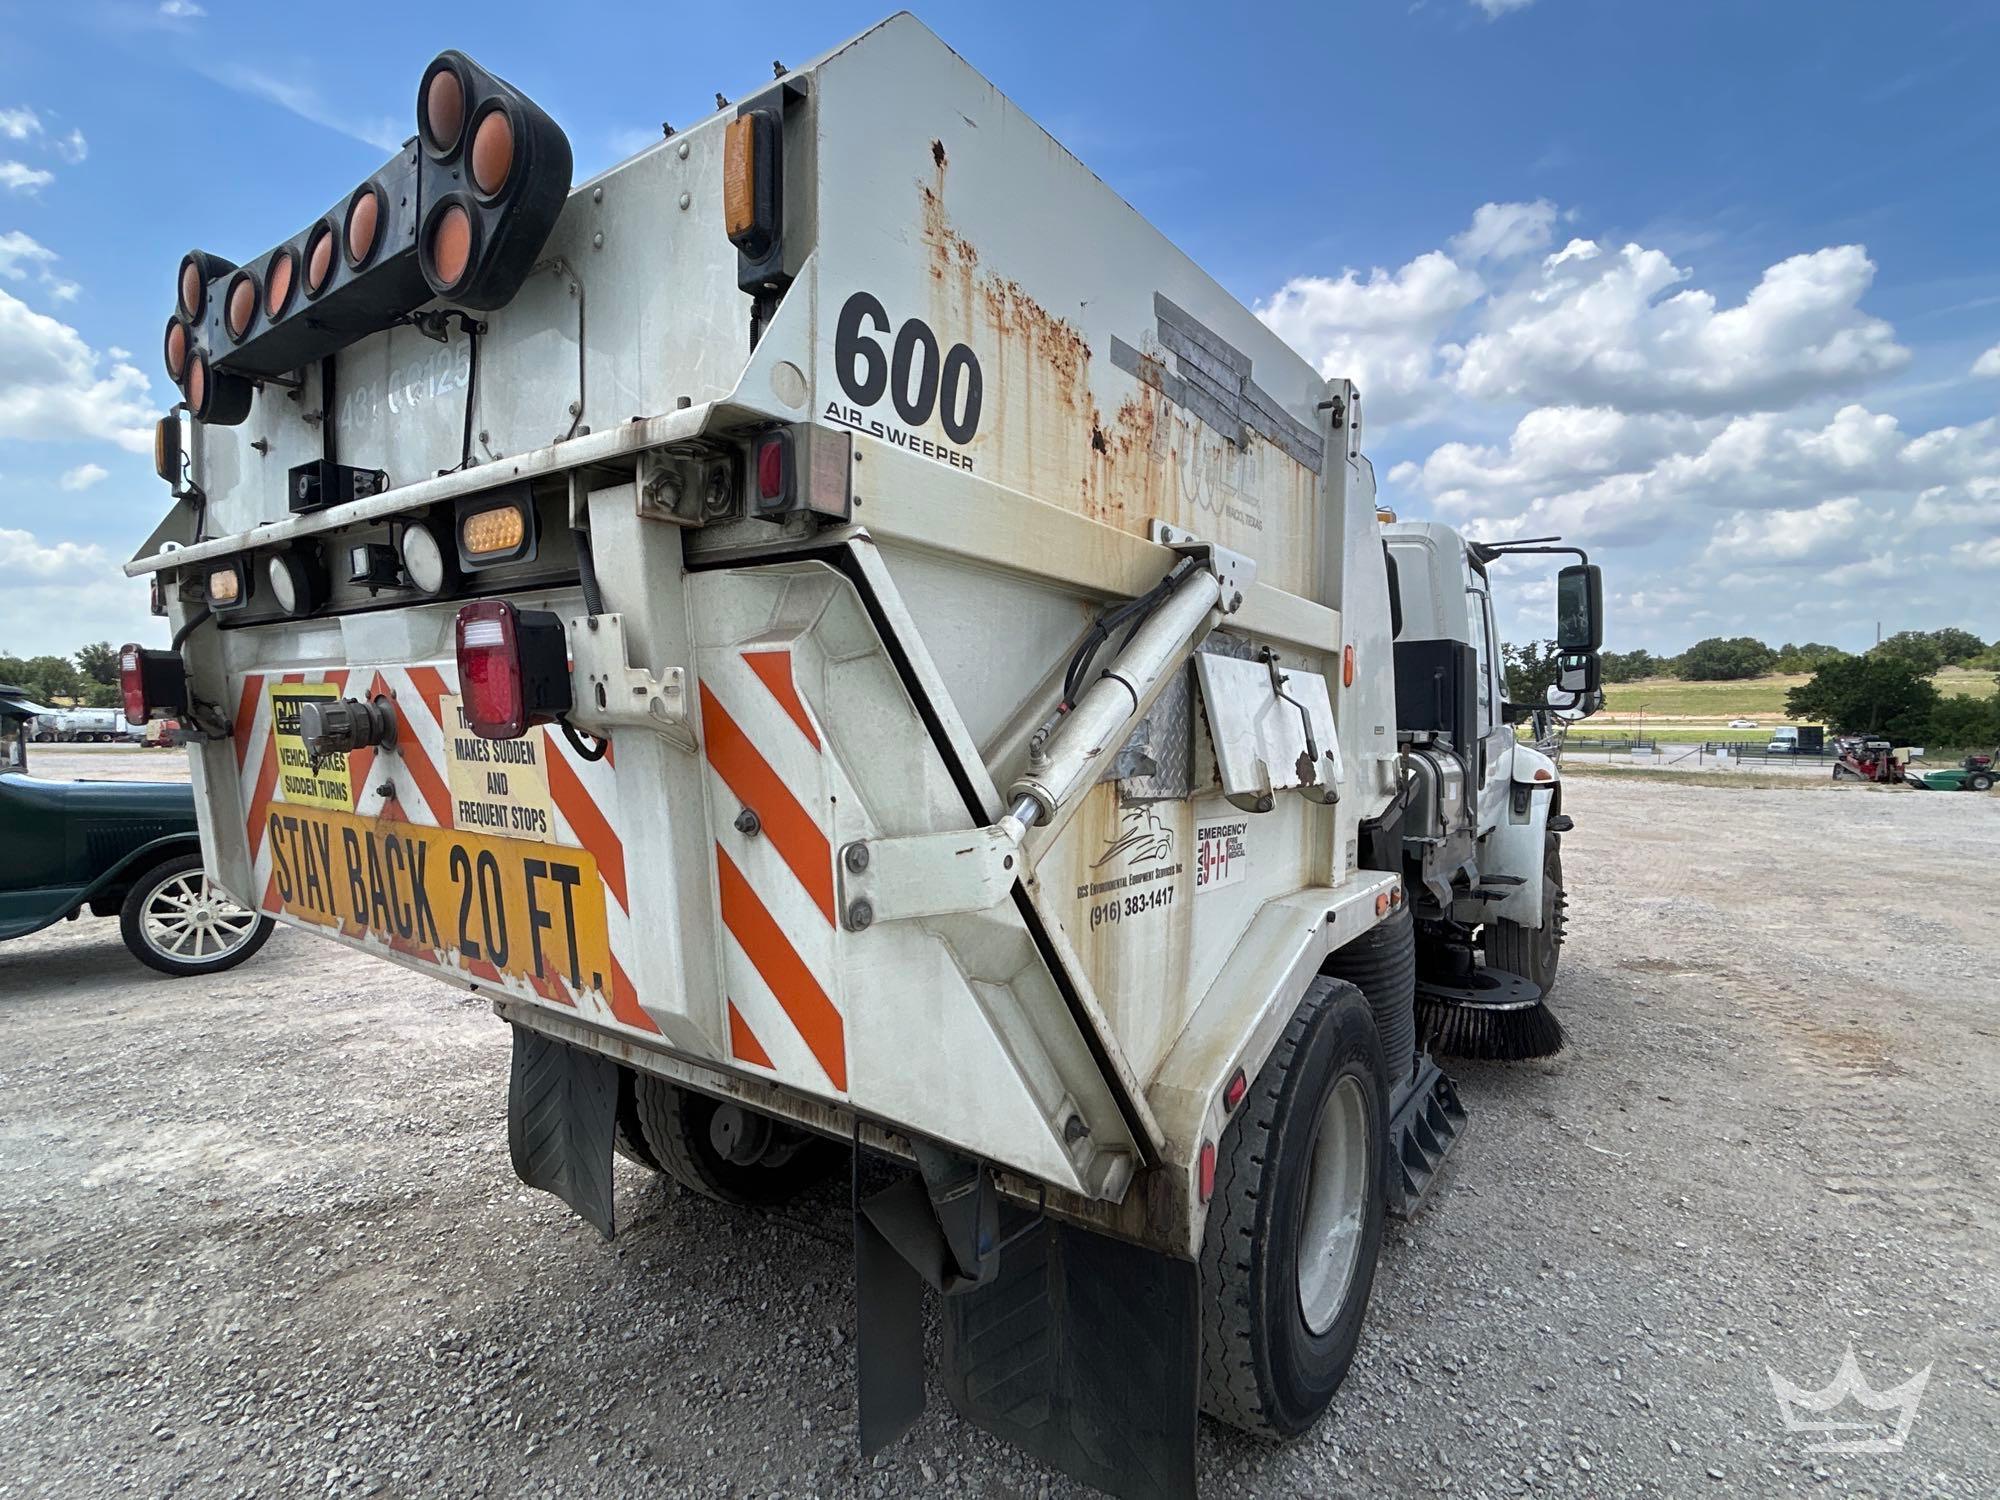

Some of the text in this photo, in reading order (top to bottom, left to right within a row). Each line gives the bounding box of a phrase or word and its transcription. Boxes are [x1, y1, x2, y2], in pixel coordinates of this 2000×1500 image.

[835, 291, 983, 445] 600
[825, 401, 974, 472] AIR SWEEPER
[455, 738, 536, 765] MAKES SUDDEN
[285, 775, 348, 802] SUDDEN TURNS
[487, 772, 509, 796] AND
[458, 800, 547, 834] FREQUENT STOPS
[1198, 822, 1247, 841] EMERGENCY
[1203, 837, 1230, 885] 9-1-1
[269, 812, 603, 991] STAY BACK 20 FT.
[1090, 885, 1174, 933] (916) 383-1417
